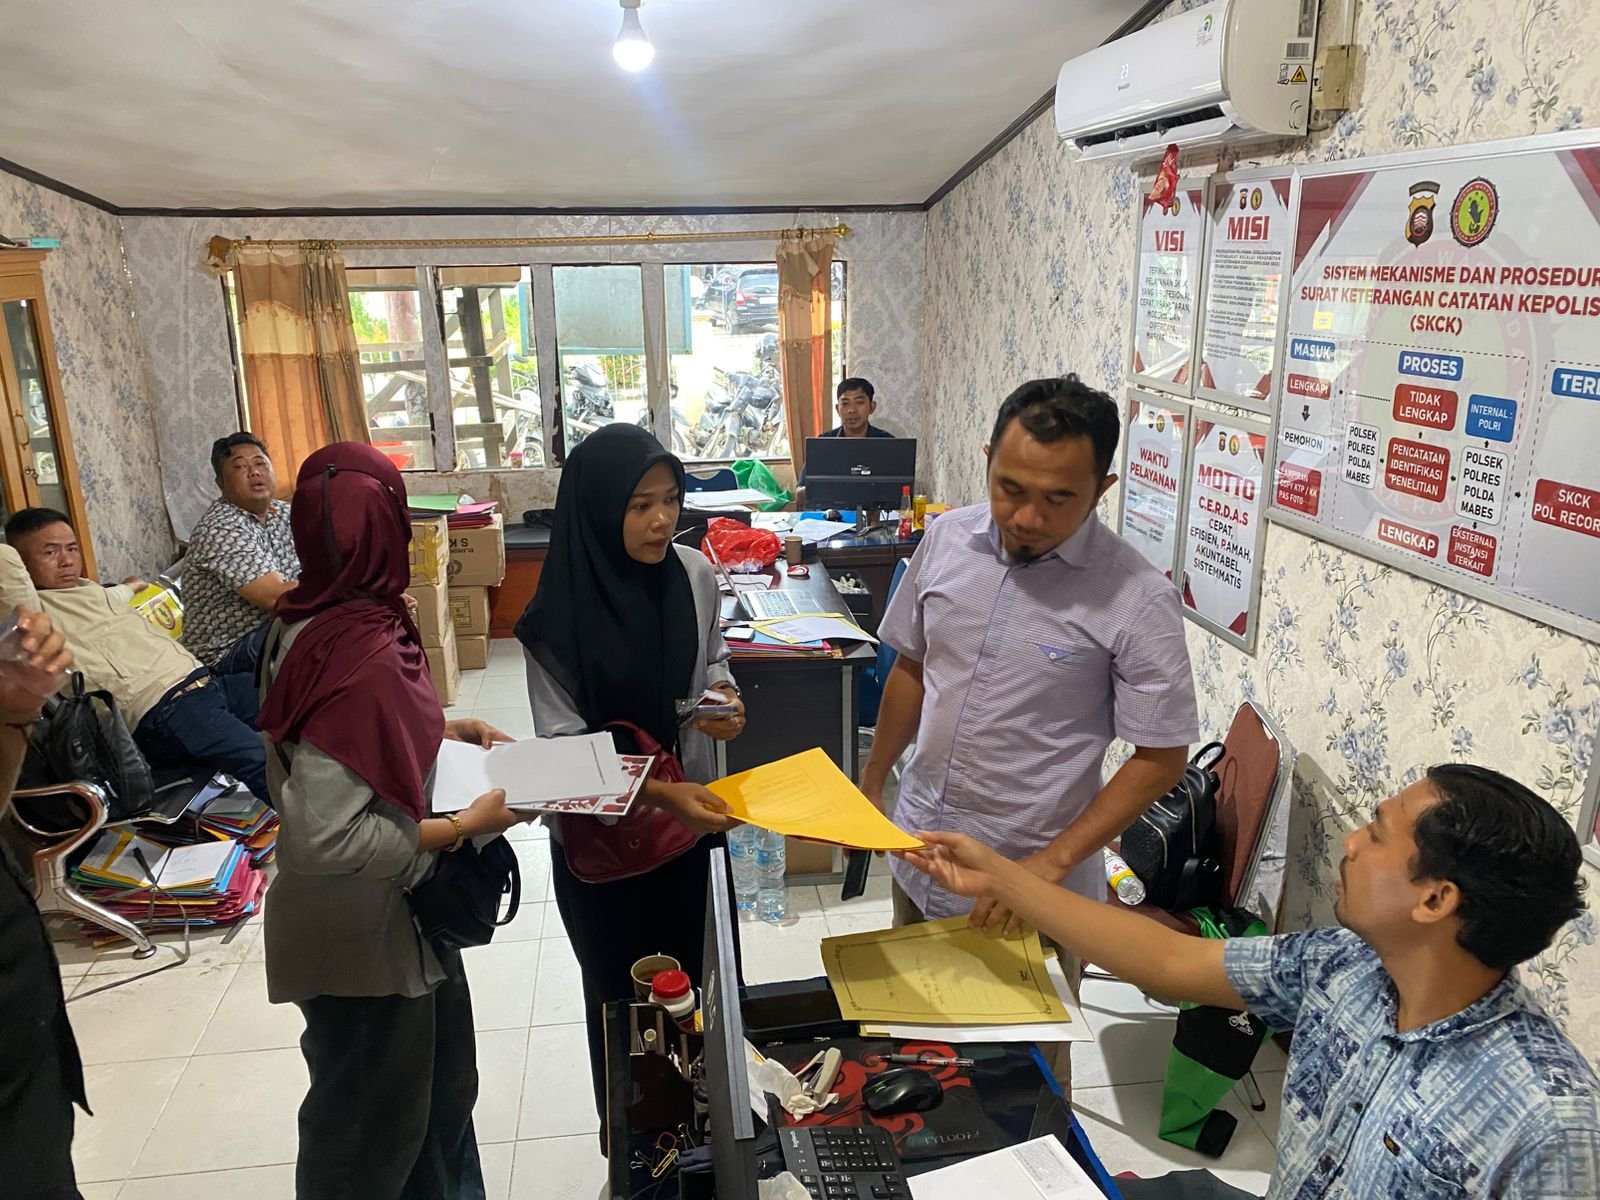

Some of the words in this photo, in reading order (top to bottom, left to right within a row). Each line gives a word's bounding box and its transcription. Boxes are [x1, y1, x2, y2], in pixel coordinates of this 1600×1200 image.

[1227, 216, 1270, 240] MISI
[1155, 230, 1185, 251] VISI
[1323, 265, 1367, 280] SISTEM
[1370, 265, 1456, 283] MEKANISME
[1459, 266, 1496, 284] DAN
[1500, 267, 1600, 287] PROSEDUR
[1301, 286, 1338, 301] SURAT
[1341, 288, 1435, 307] KETERANGAN
[1438, 291, 1514, 312] CATATAN
[1410, 314, 1463, 336] (SKCK)
[1294, 343, 1331, 360] MASUK
[1402, 355, 1458, 376] PROSES
[1410, 391, 1442, 406] TIDAK
[1400, 406, 1448, 424] LENGKAP
[1471, 404, 1508, 418] INTERNAL
[1349, 426, 1377, 441] POLSEK
[1478, 419, 1501, 431] POLRI
[1284, 432, 1323, 450] PEMOHON
[1347, 441, 1375, 456] POLRES
[1140, 447, 1169, 469] WAKTU
[1348, 455, 1371, 470] POLDA
[1392, 443, 1445, 465] PENCATATAN
[1465, 451, 1503, 470] POLSEK
[1130, 461, 1177, 492] PELAYANAN
[1345, 469, 1371, 484] MABES
[1390, 459, 1443, 481] IDENTIFIKASI
[1463, 468, 1501, 487] POLRES
[1198, 463, 1256, 501] MOTTO
[1293, 483, 1305, 493] KTP
[1309, 487, 1318, 499] KK
[1278, 490, 1290, 501] PAS
[1289, 493, 1304, 505] FOTO
[1463, 485, 1495, 503] POLDA
[1558, 489, 1591, 509] SKCK
[1460, 501, 1493, 519] MABES
[1533, 503, 1557, 521] POL
[1208, 518, 1234, 539] CEPAT,
[1380, 523, 1436, 552] LENGKAP
[1452, 527, 1494, 549] EKSTERNAL
[1454, 554, 1486, 572] TERKAIT
